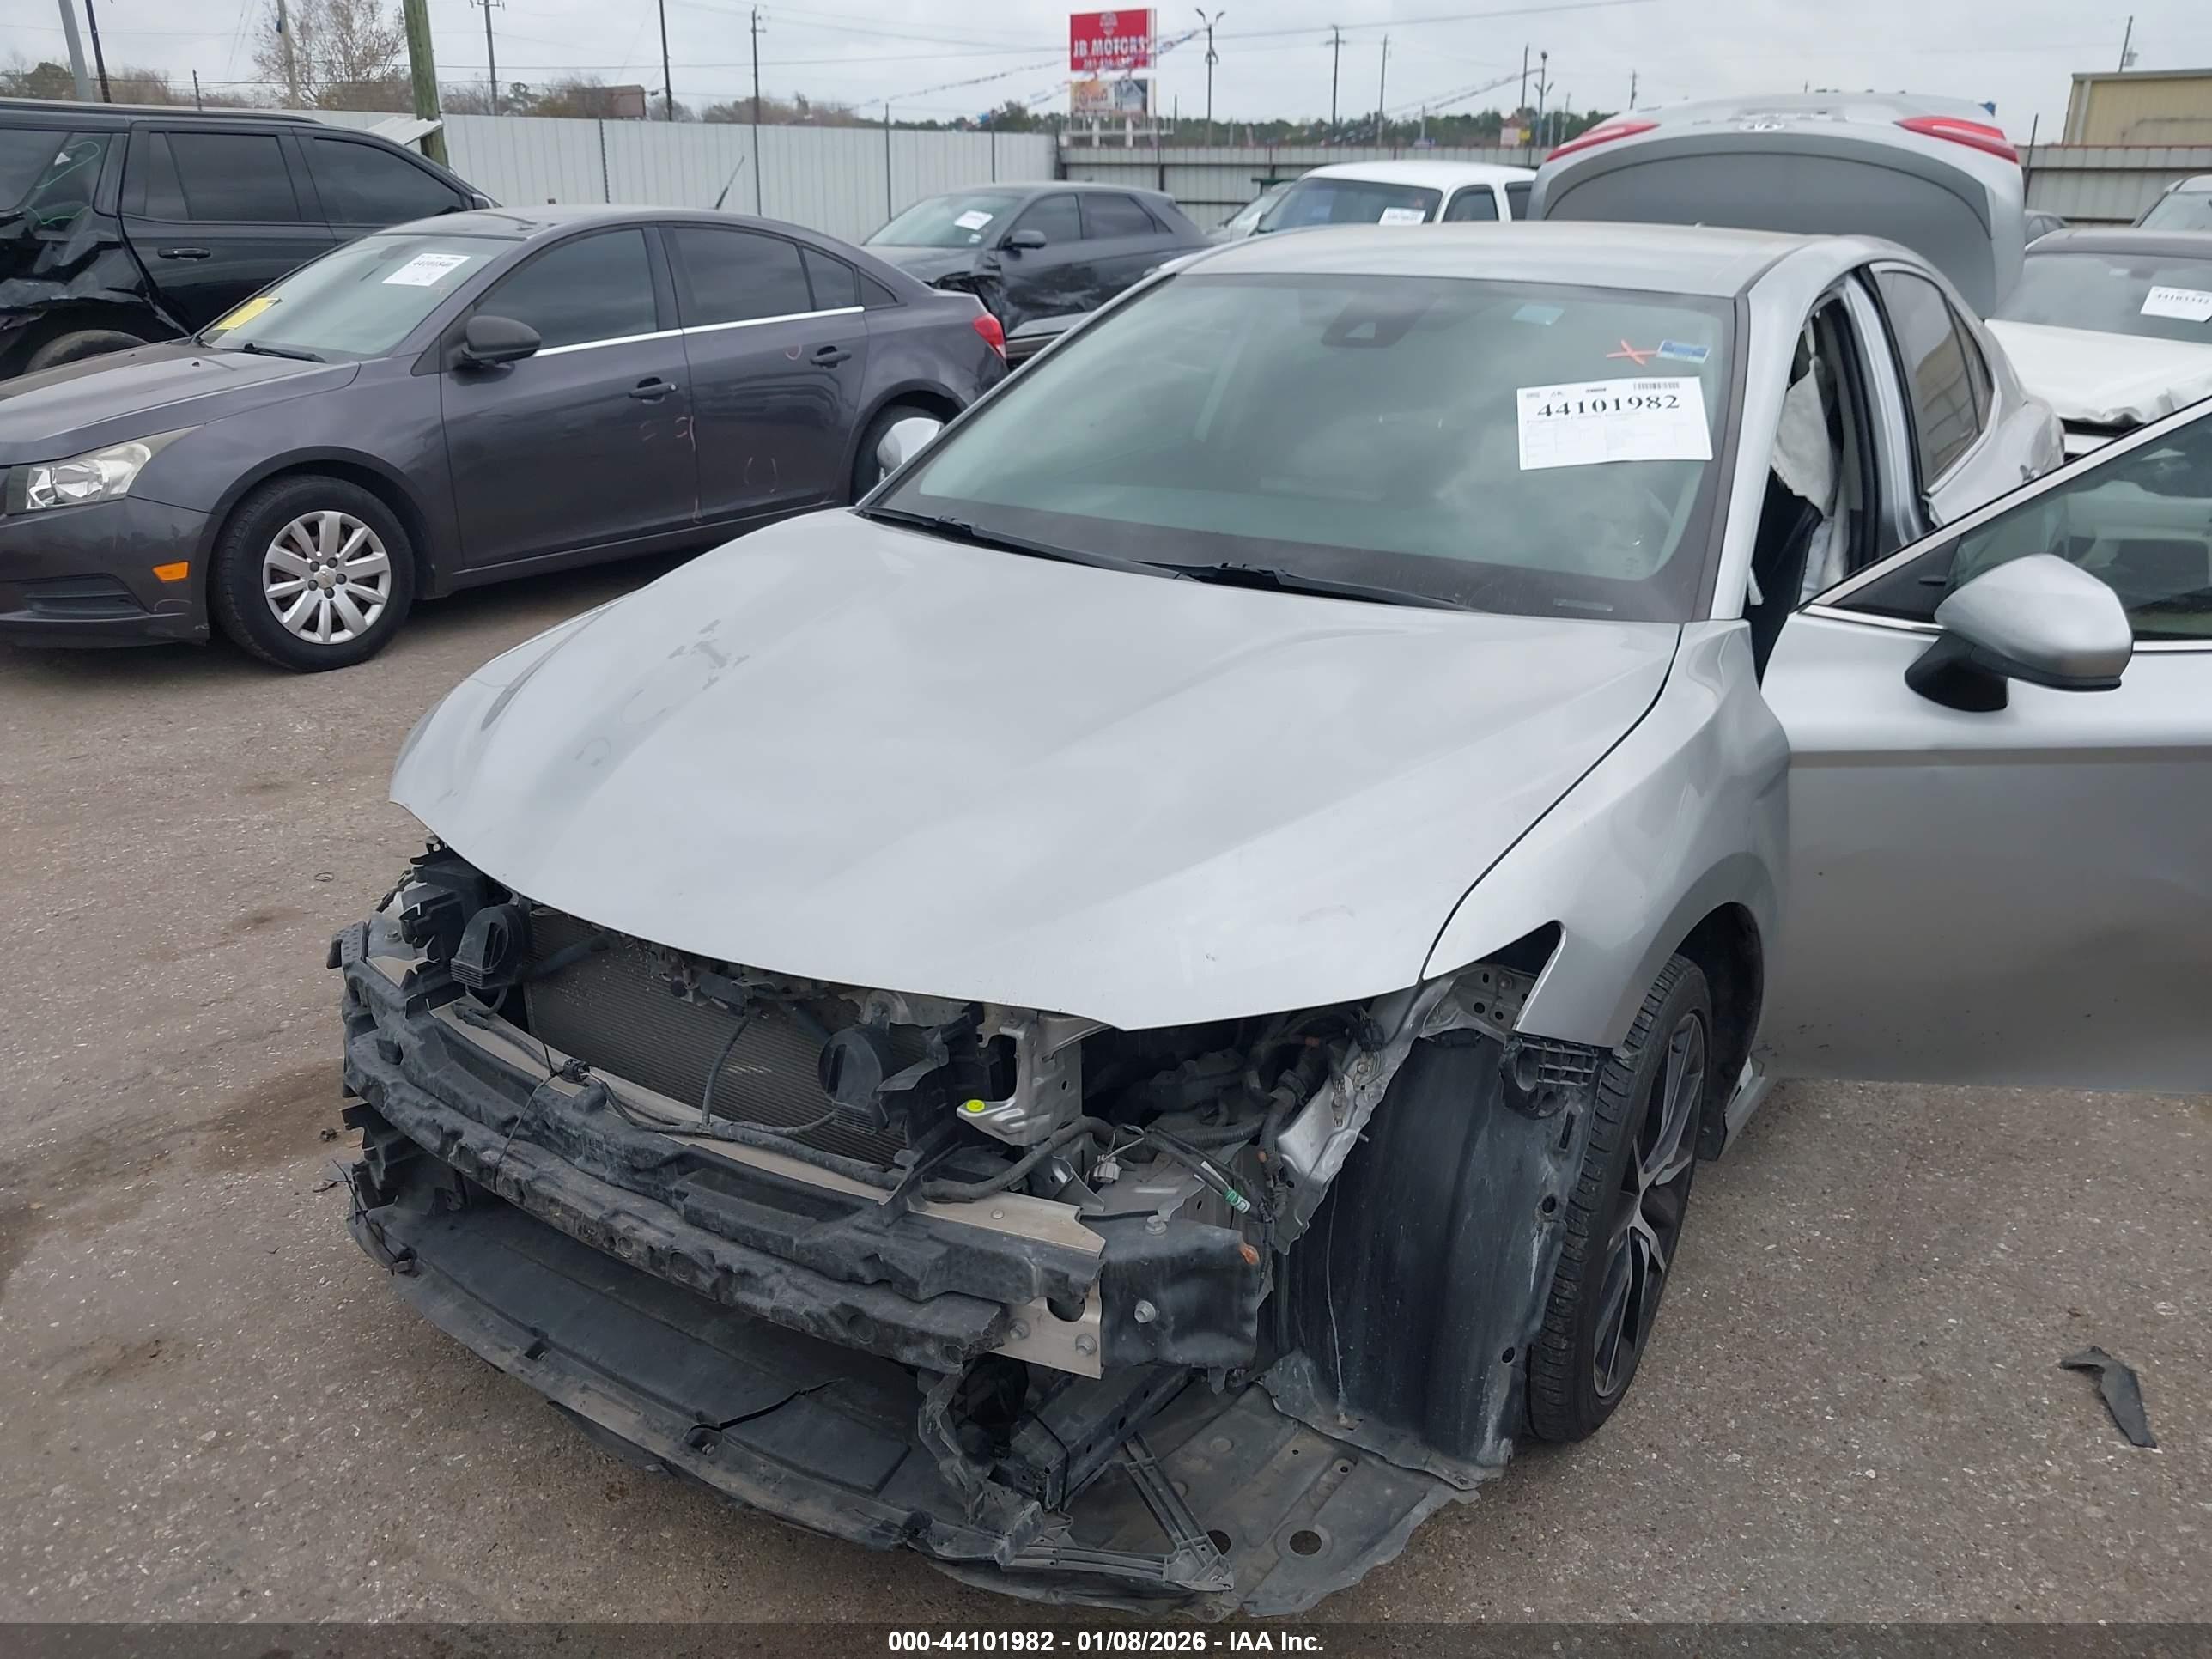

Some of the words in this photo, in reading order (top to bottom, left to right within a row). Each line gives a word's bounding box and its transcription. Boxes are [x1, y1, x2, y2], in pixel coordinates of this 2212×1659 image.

[1073, 40, 1088, 58] JB
[1092, 37, 1146, 56] MOTORS
[1537, 394, 1680, 417] 44101982
